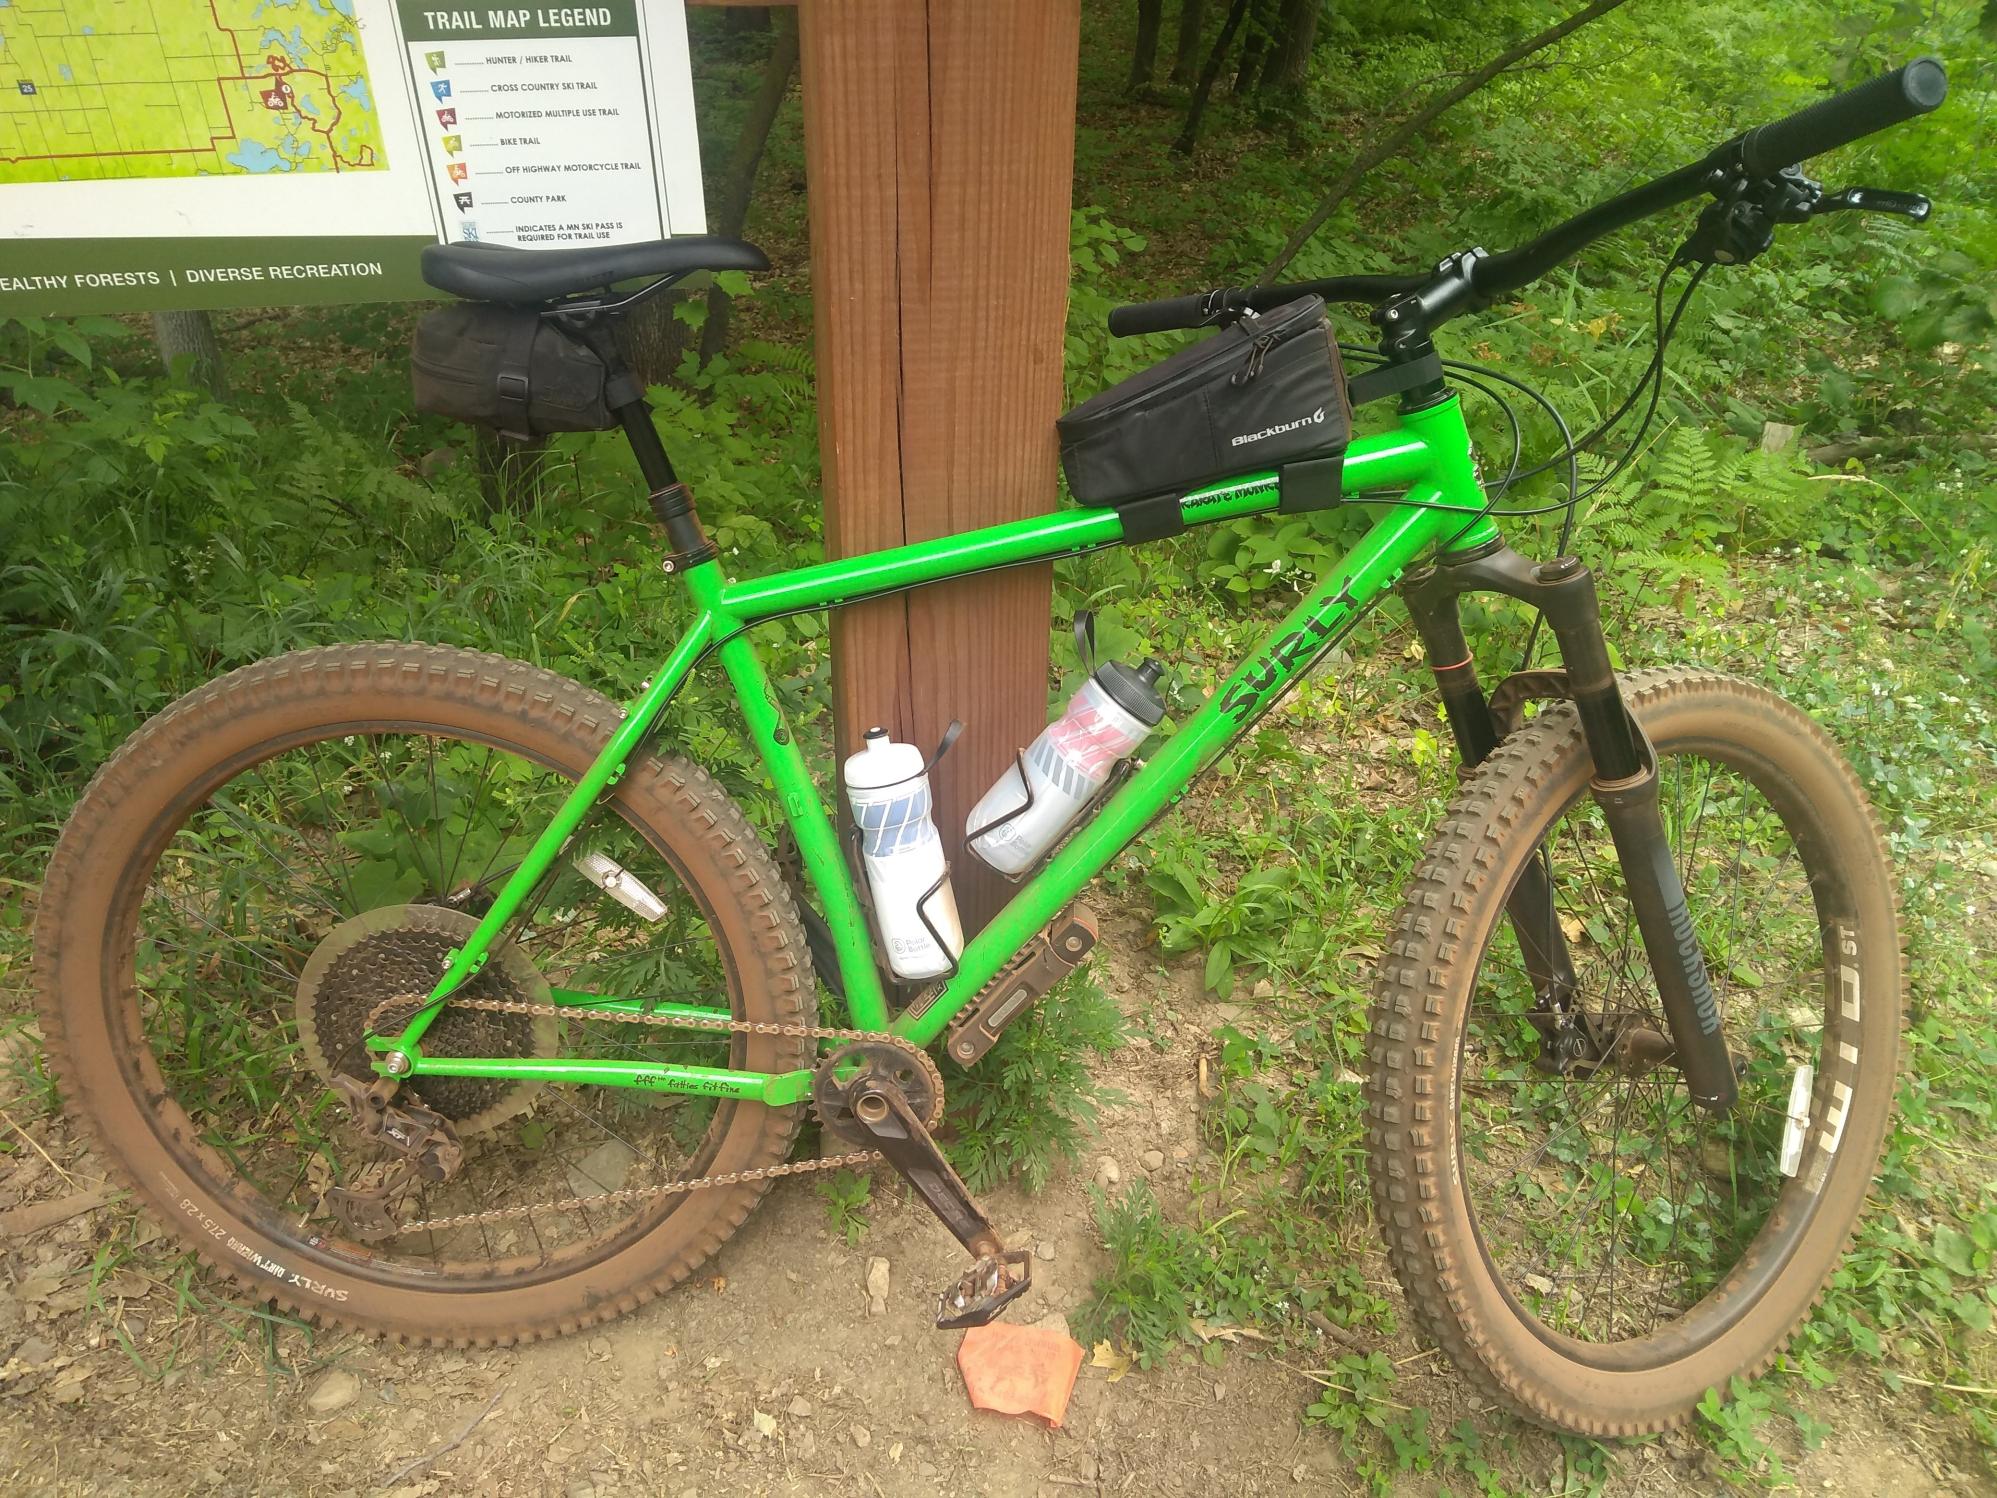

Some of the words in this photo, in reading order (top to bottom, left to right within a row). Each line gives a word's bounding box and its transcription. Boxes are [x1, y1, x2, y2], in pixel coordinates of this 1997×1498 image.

[424, 10, 482, 30] TRAIL
[488, 10, 530, 28] MAP
[538, 7, 612, 27] LEGEND
[486, 56, 518, 64] HUNTER
[525, 55, 549, 64] HIKER
[550, 54, 572, 63] TRAIL
[490, 84, 519, 92] CROSS
[520, 83, 560, 92] COUNTRY
[562, 82, 575, 91] SKI
[576, 82, 598, 90] TRAIL
[496, 110, 542, 119] MOTORIZED
[545, 109, 580, 118] MULTIPLE
[582, 108, 597, 117] USE
[598, 108, 620, 116] TRAIL
[500, 138, 518, 146] BIKE
[519, 137, 540, 145] TRAIL
[505, 166, 520, 174] OFF
[522, 164, 561, 174] HIGHWAY
[564, 163, 619, 172] MOTORCYCLE
[620, 162, 641, 170] TRAIL
[510, 196, 544, 204] COUNTY
[546, 195, 566, 204] PARK
[515, 224, 556, 234] INDICATES
[558, 224, 564, 232] A
[566, 223, 580, 232] MN
[581, 223, 593, 232] SKI
[594, 222, 614, 231] PASS
[616, 222, 623, 230] IS
[518, 233, 556, 242] REQUIRED
[557, 232, 572, 241] FOR
[574, 232, 594, 240] TRAIL
[596, 232, 610, 240] USE
[0, 276, 68, 291] EALTHY
[74, 272, 160, 288] FORESTS
[186, 267, 264, 284] DIVERSE
[269, 262, 382, 280] RECREATION
[1232, 416, 1312, 446] Blackburn
[1220, 575, 1358, 724] SURLY
[1840, 925, 1858, 957] ST
[668, 1079, 698, 1090] fatties
[180, 1198, 198, 1216] 2.8
[202, 1219, 227, 1240] 27.5
[289, 1274, 350, 1302] SURLY
